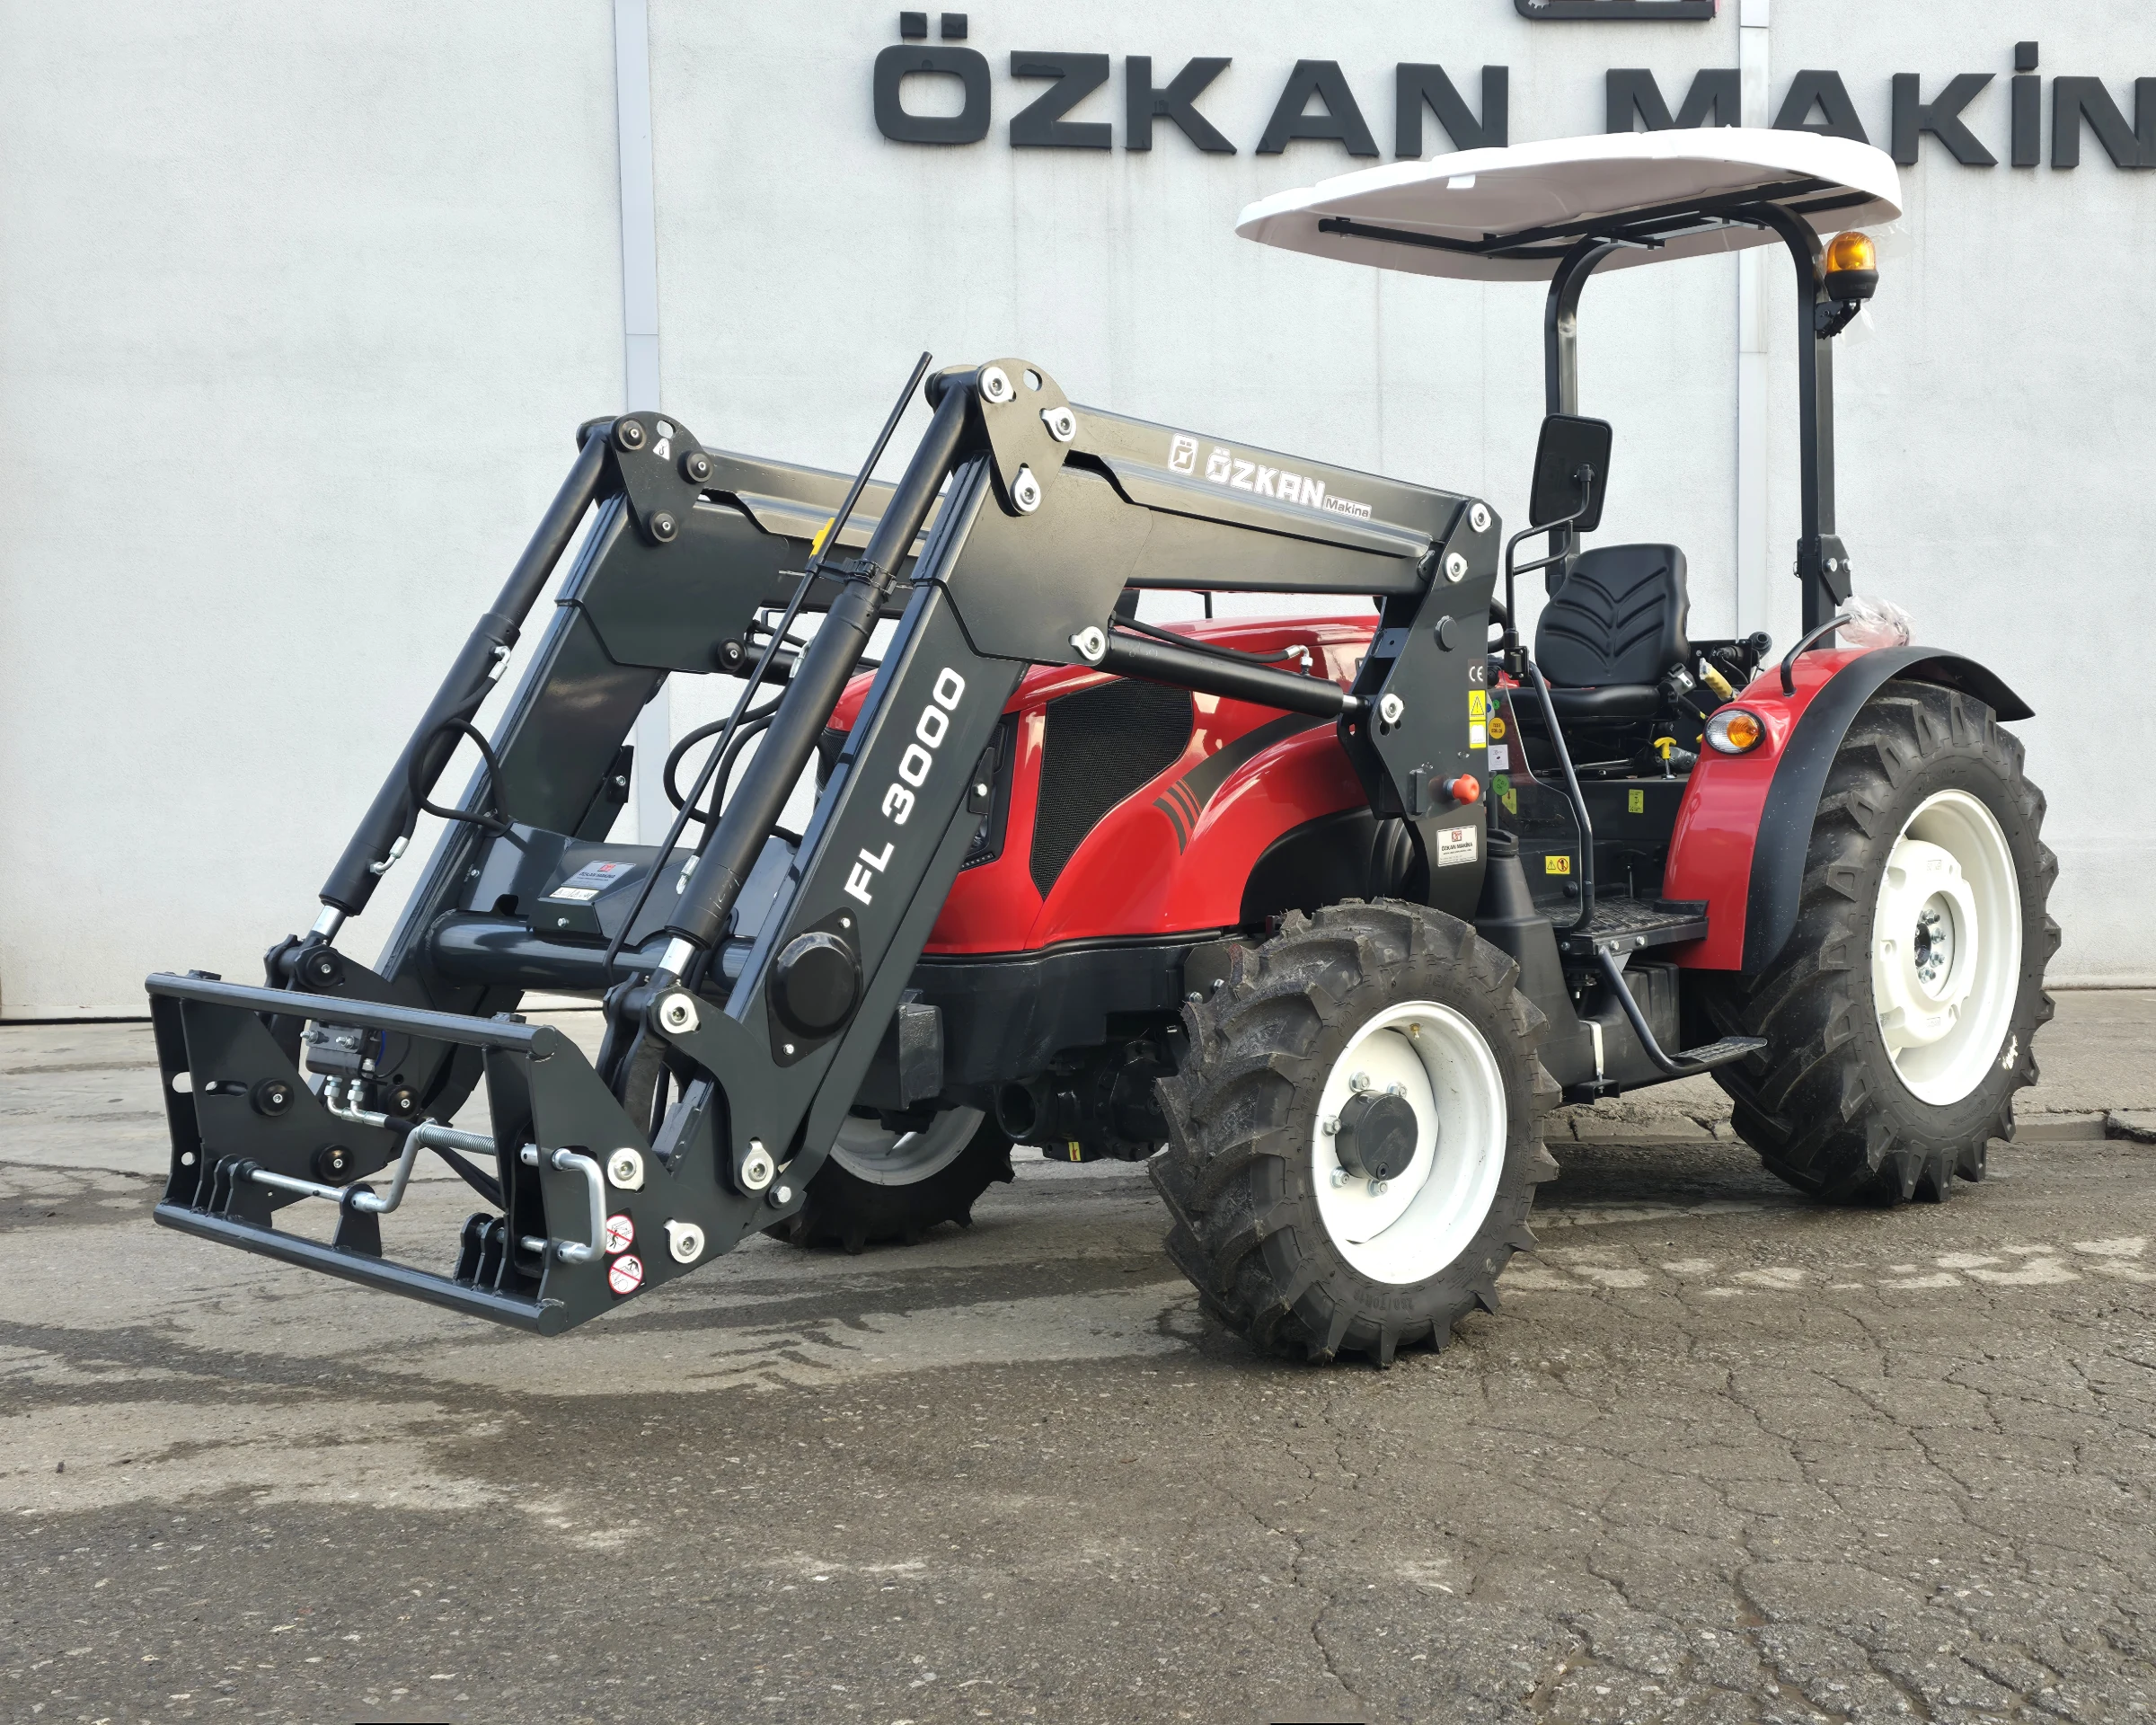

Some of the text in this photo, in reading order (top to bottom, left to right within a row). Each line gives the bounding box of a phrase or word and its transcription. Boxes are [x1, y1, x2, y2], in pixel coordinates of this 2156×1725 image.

[873, 11, 1509, 157] ÖZKAN
[1206, 447, 1370, 518] ÖZKAN Makina
[844, 667, 966, 906] FL 3000
